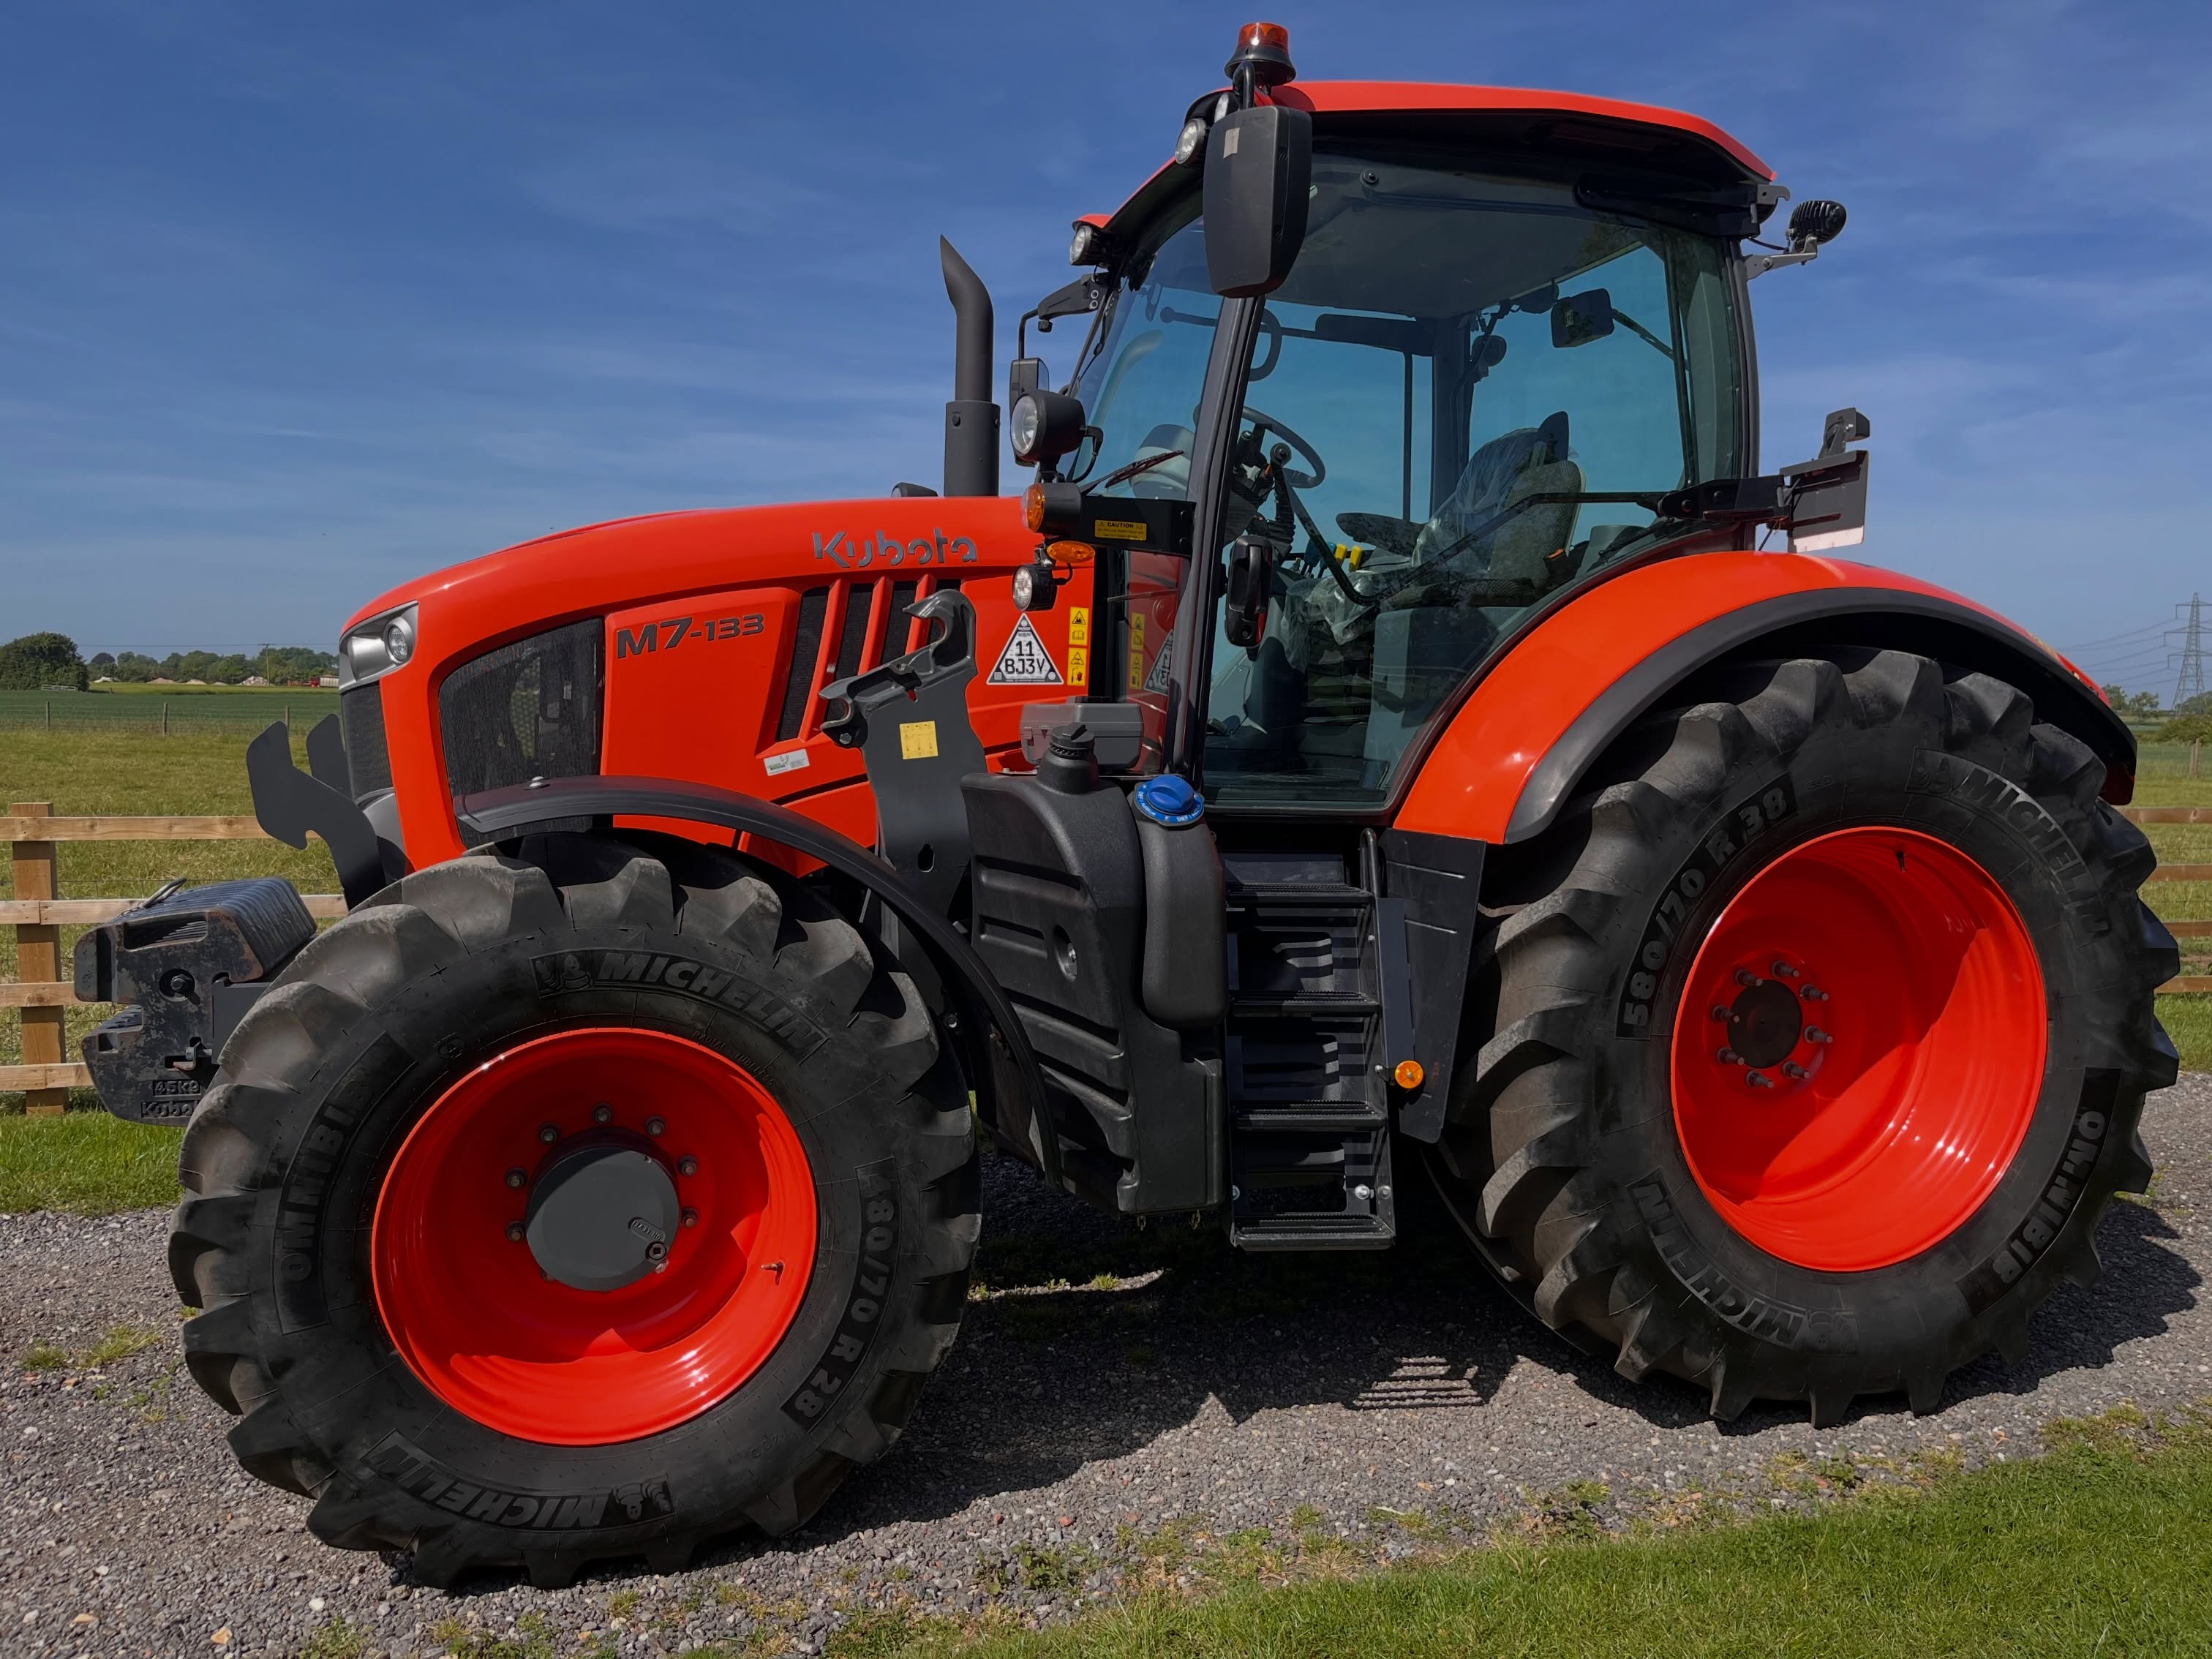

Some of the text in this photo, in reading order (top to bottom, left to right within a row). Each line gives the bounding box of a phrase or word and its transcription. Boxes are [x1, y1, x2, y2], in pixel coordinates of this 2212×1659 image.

[813, 527, 977, 568] Kubota
[617, 614, 764, 659] M7-133
[1004, 658, 1045, 674] BJ3Y
[1015, 641, 1034, 657] 11
[1959, 768, 2111, 936] MICHELIN
[1624, 788, 1786, 1026] 580/70 R 38
[596, 952, 824, 1056] MICHELIN
[154, 1080, 199, 1094] 45kg
[1993, 1110, 2106, 1284] OMNIBIB
[795, 1175, 894, 1418] 480/70 R 28
[1633, 1183, 1804, 1344] MICHELIN
[369, 1445, 611, 1527] MICHELIN
